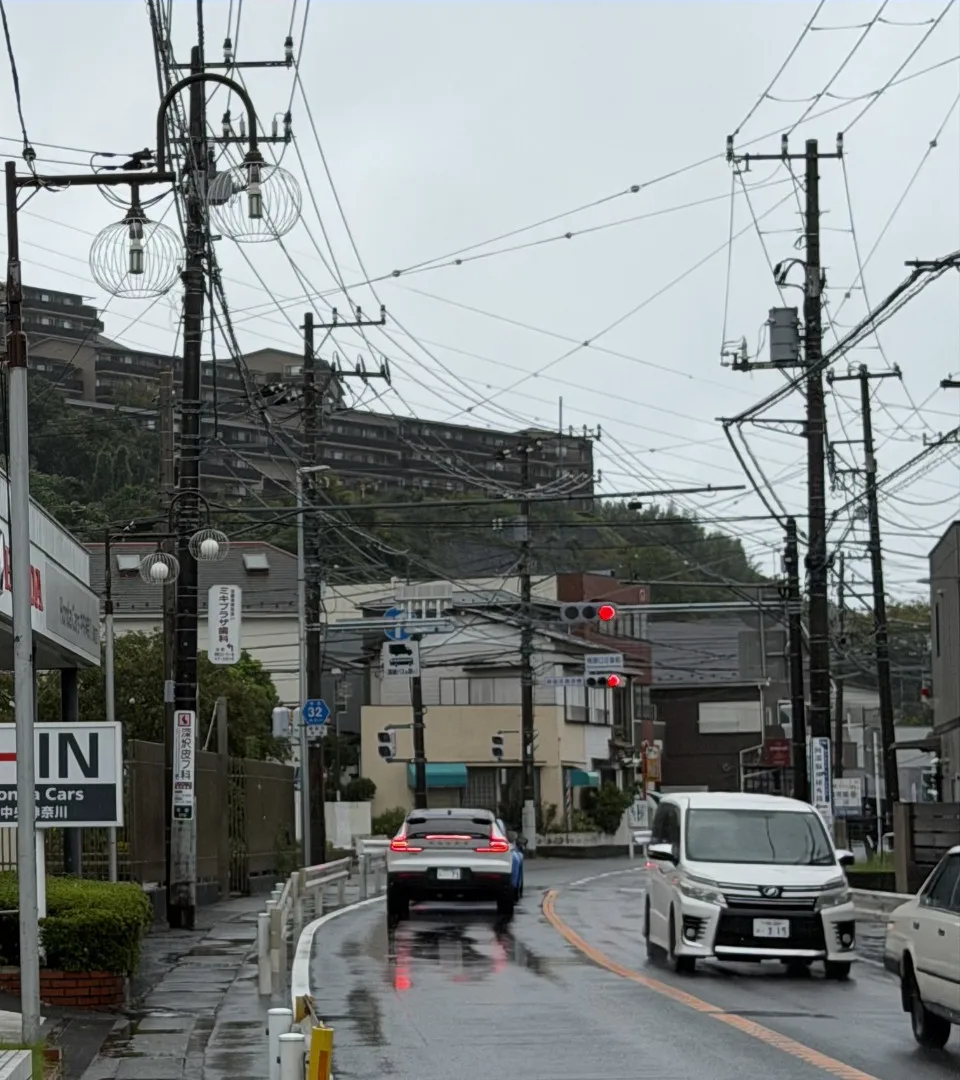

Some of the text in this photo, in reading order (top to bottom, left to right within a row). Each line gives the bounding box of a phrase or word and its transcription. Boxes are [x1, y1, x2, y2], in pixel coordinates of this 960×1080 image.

[307, 706, 323, 718] 32
[39, 732, 99, 779] IN
[45, 787, 84, 801] Cars
[0, 805, 68, 819] 中奈川
